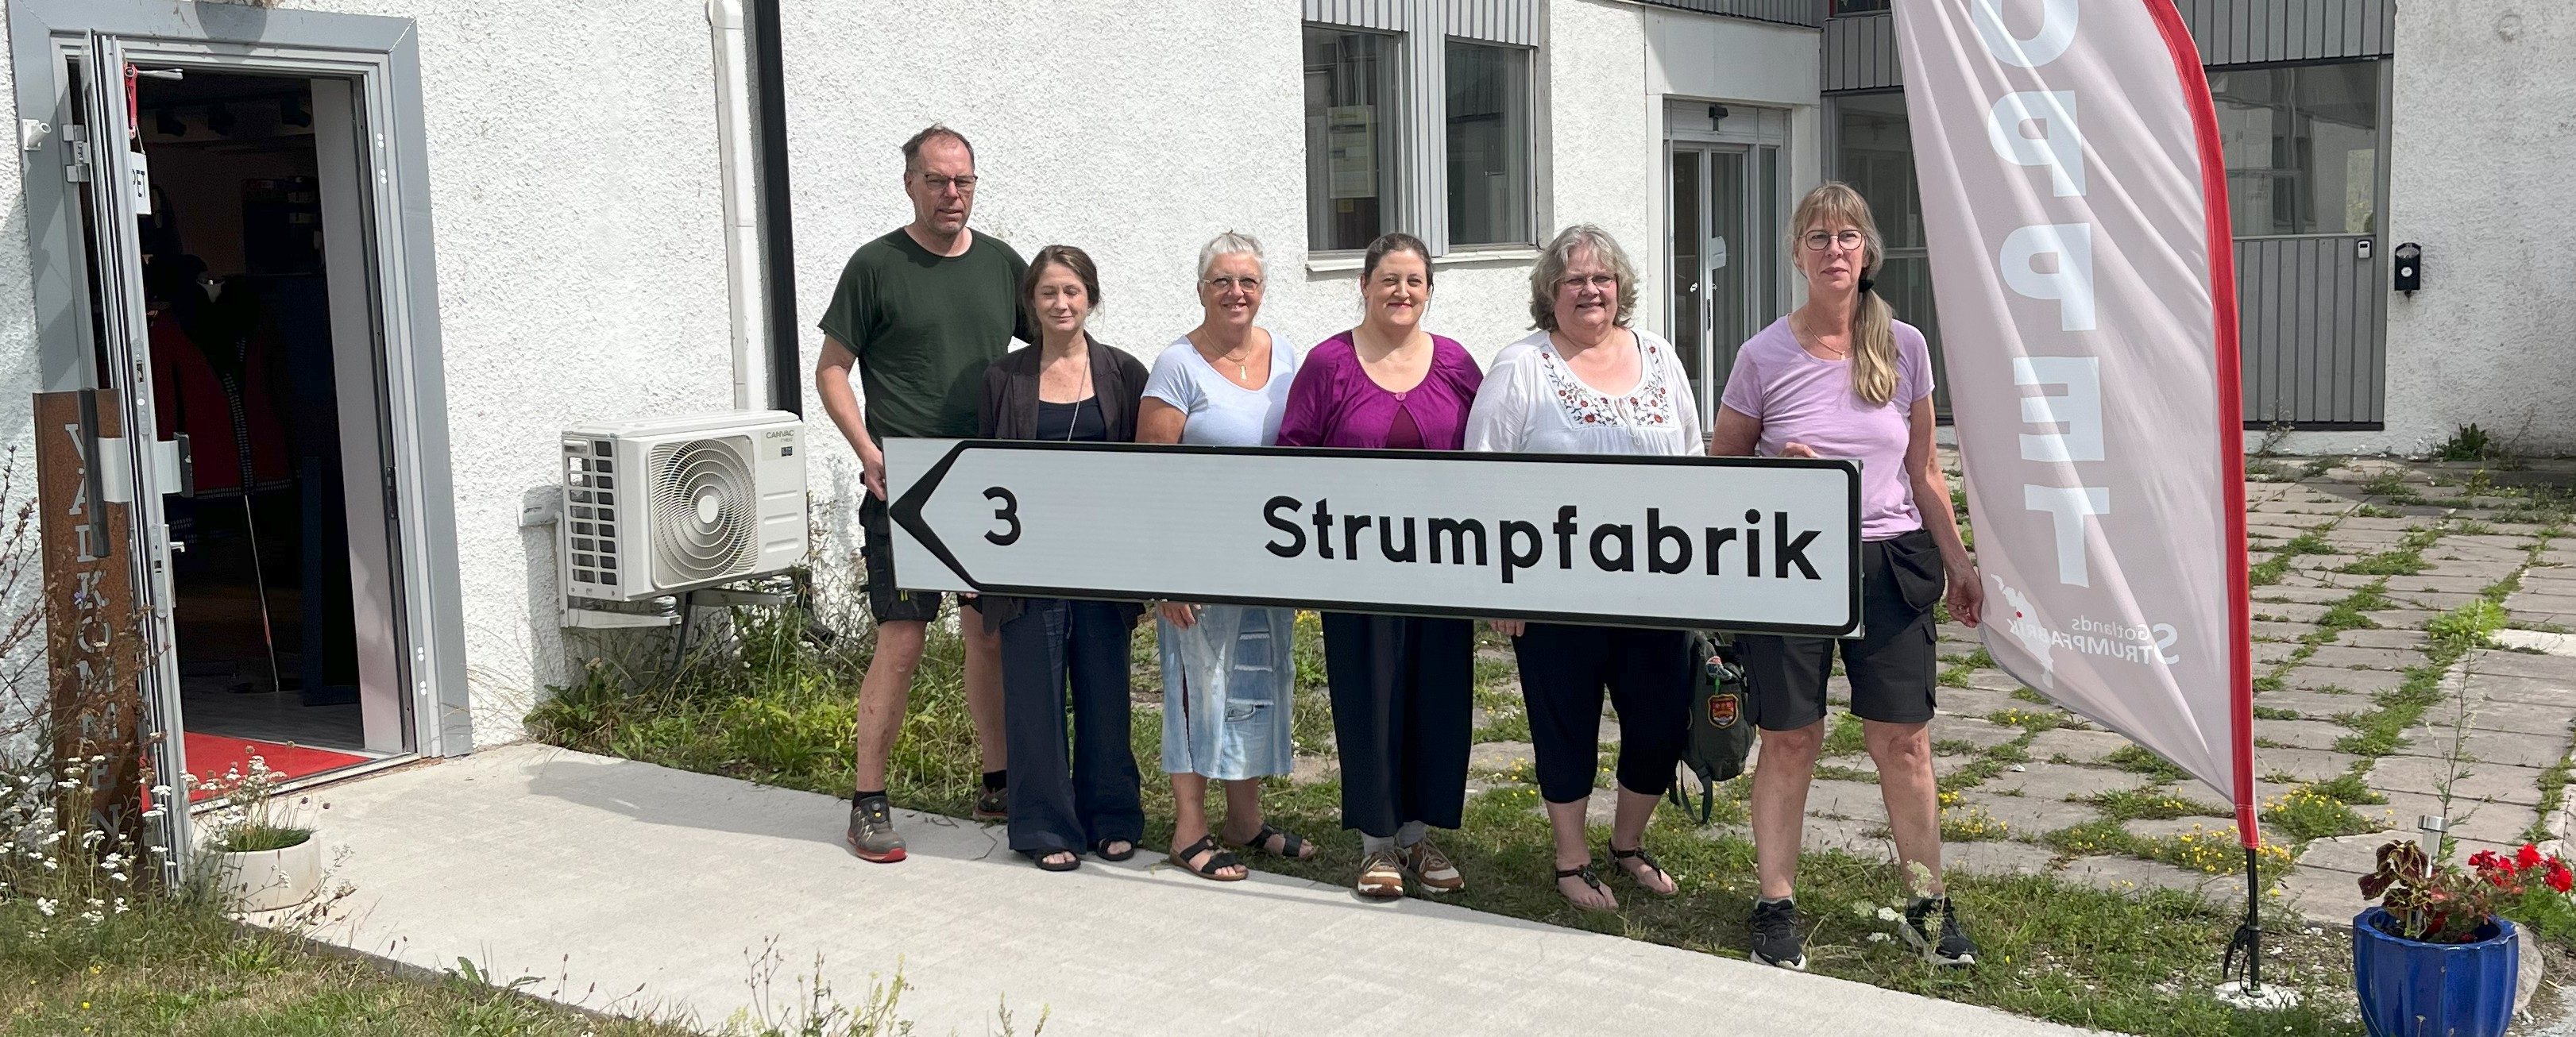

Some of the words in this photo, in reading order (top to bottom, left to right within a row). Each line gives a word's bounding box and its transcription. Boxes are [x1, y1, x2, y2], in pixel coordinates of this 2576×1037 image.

[766, 430, 795, 438] CANVAC
[983, 486, 1022, 545] 3
[1263, 495, 1822, 584] Strumpfabrik
